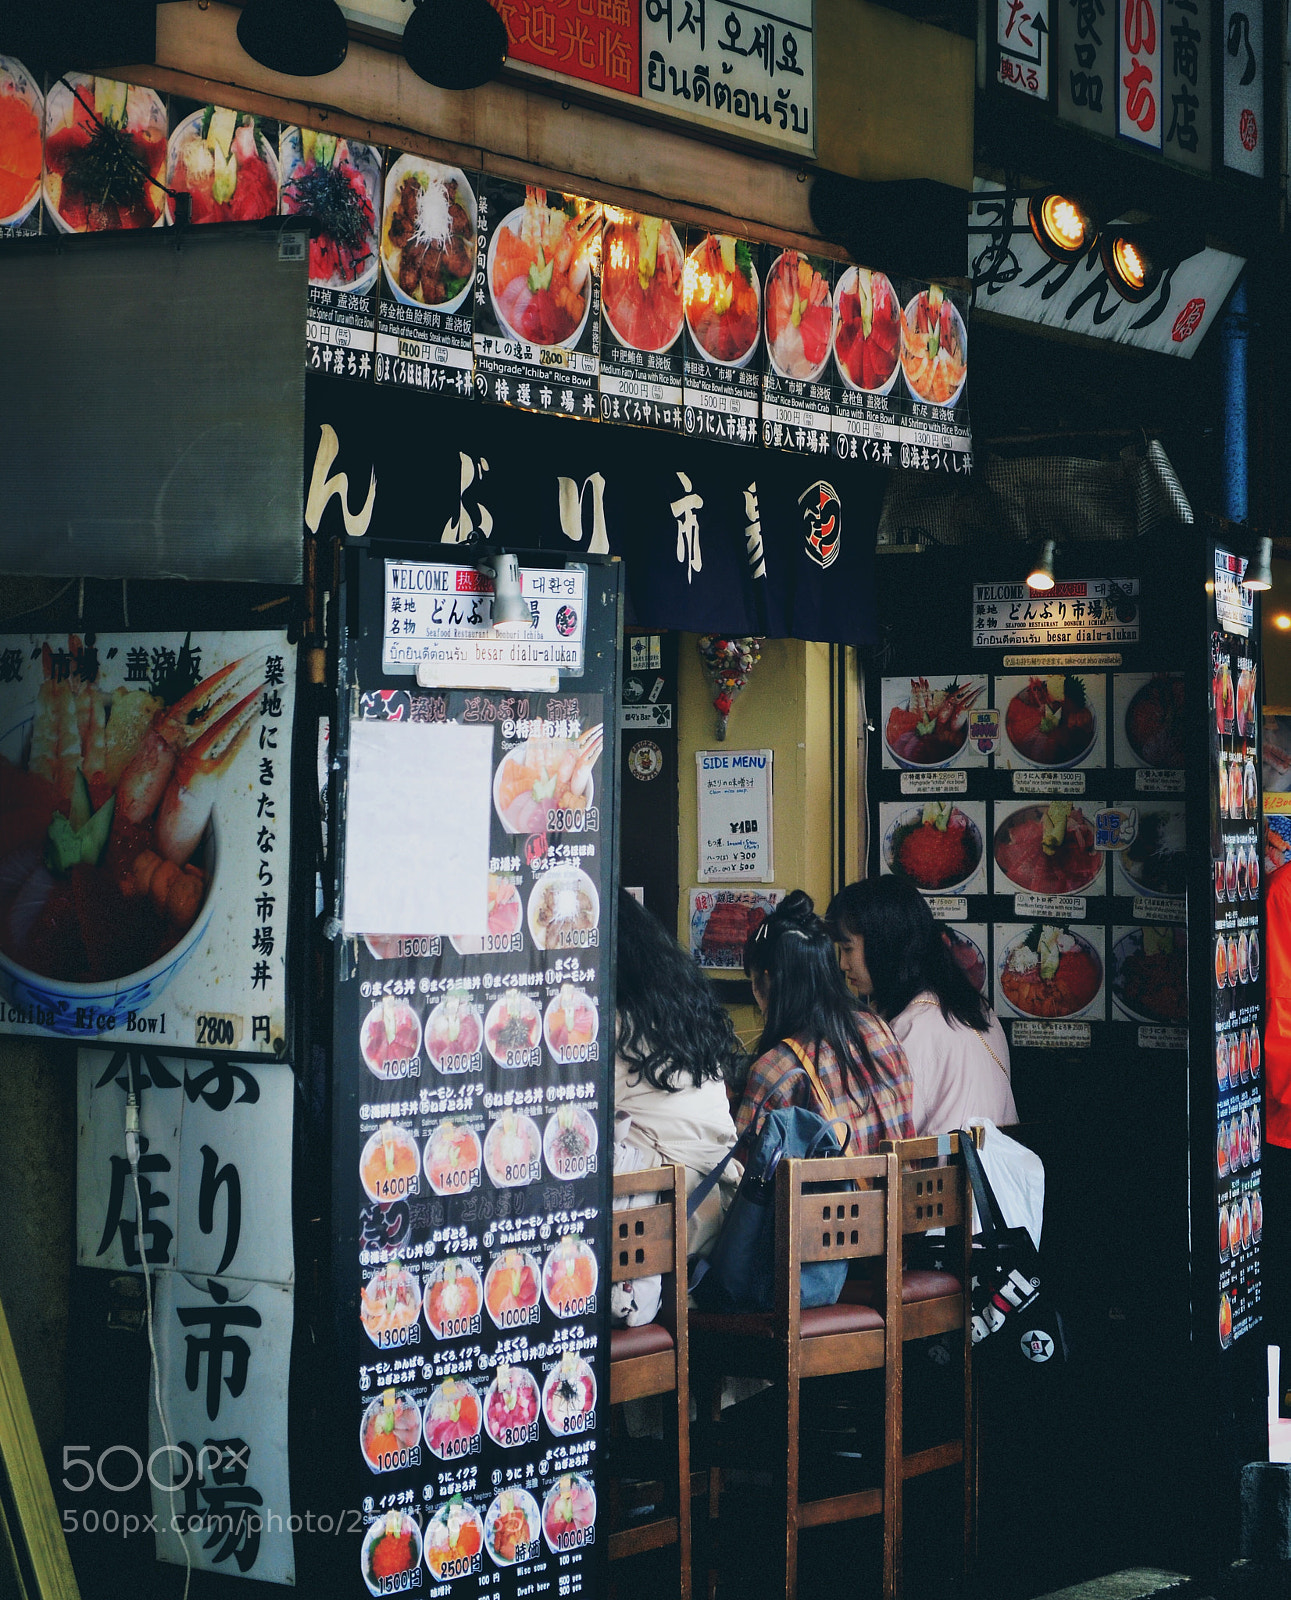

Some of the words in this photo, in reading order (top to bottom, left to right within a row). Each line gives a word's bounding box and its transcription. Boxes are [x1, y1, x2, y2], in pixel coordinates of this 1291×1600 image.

[718, 11, 804, 77] 오세요
[648, 50, 809, 134] ยินดีต้อนรับ
[572, 374, 591, 387] Bowl
[600, 363, 621, 375] Medium
[621, 366, 634, 380] Fatty
[634, 368, 647, 381] Tuna
[648, 372, 659, 382] with
[659, 373, 669, 385] Rice
[670, 375, 682, 387] Bowl
[701, 380, 711, 391] Rice
[711, 382, 723, 393] Bowl
[735, 387, 743, 397] Sea
[791, 397, 805, 408] Bowl
[805, 401, 817, 411] with
[817, 403, 830, 413] Crab
[835, 405, 850, 416] Tuna
[850, 408, 864, 419] with
[866, 410, 879, 421] Rice
[880, 414, 895, 425] Bowl
[908, 417, 928, 431] Shrimp
[928, 421, 941, 433] with
[941, 424, 953, 435] Rice
[392, 568, 449, 591] WELCOME
[532, 576, 576, 595] 대환영
[977, 585, 1024, 600] WELCOME
[390, 597, 417, 613] 築地
[975, 604, 998, 615] 築地
[1009, 600, 1103, 621] どんぶり市場
[390, 618, 416, 635] 名物
[975, 617, 998, 628] 名物
[426, 629, 451, 638] Seafood
[454, 629, 489, 639] Restaurant
[1047, 630, 1071, 642] besar
[1076, 628, 1137, 641] dialu-alukan
[475, 643, 504, 661] besar
[509, 645, 577, 662] dialu-alukan
[463, 696, 530, 722] どんぶり
[703, 757, 729, 769] SIDE
[732, 756, 766, 769] MENU
[250, 655, 285, 991] 築地にきたなら市場丼
[547, 806, 599, 832] 2800円
[397, 935, 442, 957] 1500円
[480, 932, 523, 952] 1300円
[559, 928, 600, 948] 1400円
[554, 957, 580, 970] まぐろ
[77, 1008, 116, 1031] Rice
[126, 1010, 166, 1034] Bowl
[196, 1015, 235, 1045] 2800
[252, 1015, 270, 1045] 円
[439, 1051, 483, 1073] 1200円
[506, 1047, 542, 1068] 800円
[559, 1041, 599, 1062] 1000円
[383, 1057, 421, 1078] 700円
[505, 1160, 542, 1181] 800円
[558, 1153, 598, 1174] 1200円
[376, 1175, 421, 1197] 1400円
[439, 1168, 482, 1189] 1400円
[500, 1304, 541, 1327] 1000円
[558, 1295, 598, 1317] 1400円
[439, 1314, 482, 1337] 1300円
[553, 1326, 585, 1343] 上まぐろ
[377, 1324, 421, 1349] 1300円
[496, 1337, 528, 1354] 上まぐろ
[563, 1410, 597, 1433] 800円
[505, 1422, 539, 1444] 800円
[439, 1434, 482, 1458] 1400円
[377, 1446, 422, 1472] 1000円
[556, 1525, 596, 1547] 1000円
[515, 1540, 541, 1562] 時価
[440, 1552, 482, 1578] 2500円
[517, 1566, 531, 1577] Miso
[533, 1563, 547, 1572] soup
[559, 1555, 570, 1566] 100
[572, 1554, 583, 1563] yen
[378, 1567, 422, 1594] 1500円
[517, 1584, 534, 1597] Draft
[537, 1582, 550, 1591] beer
